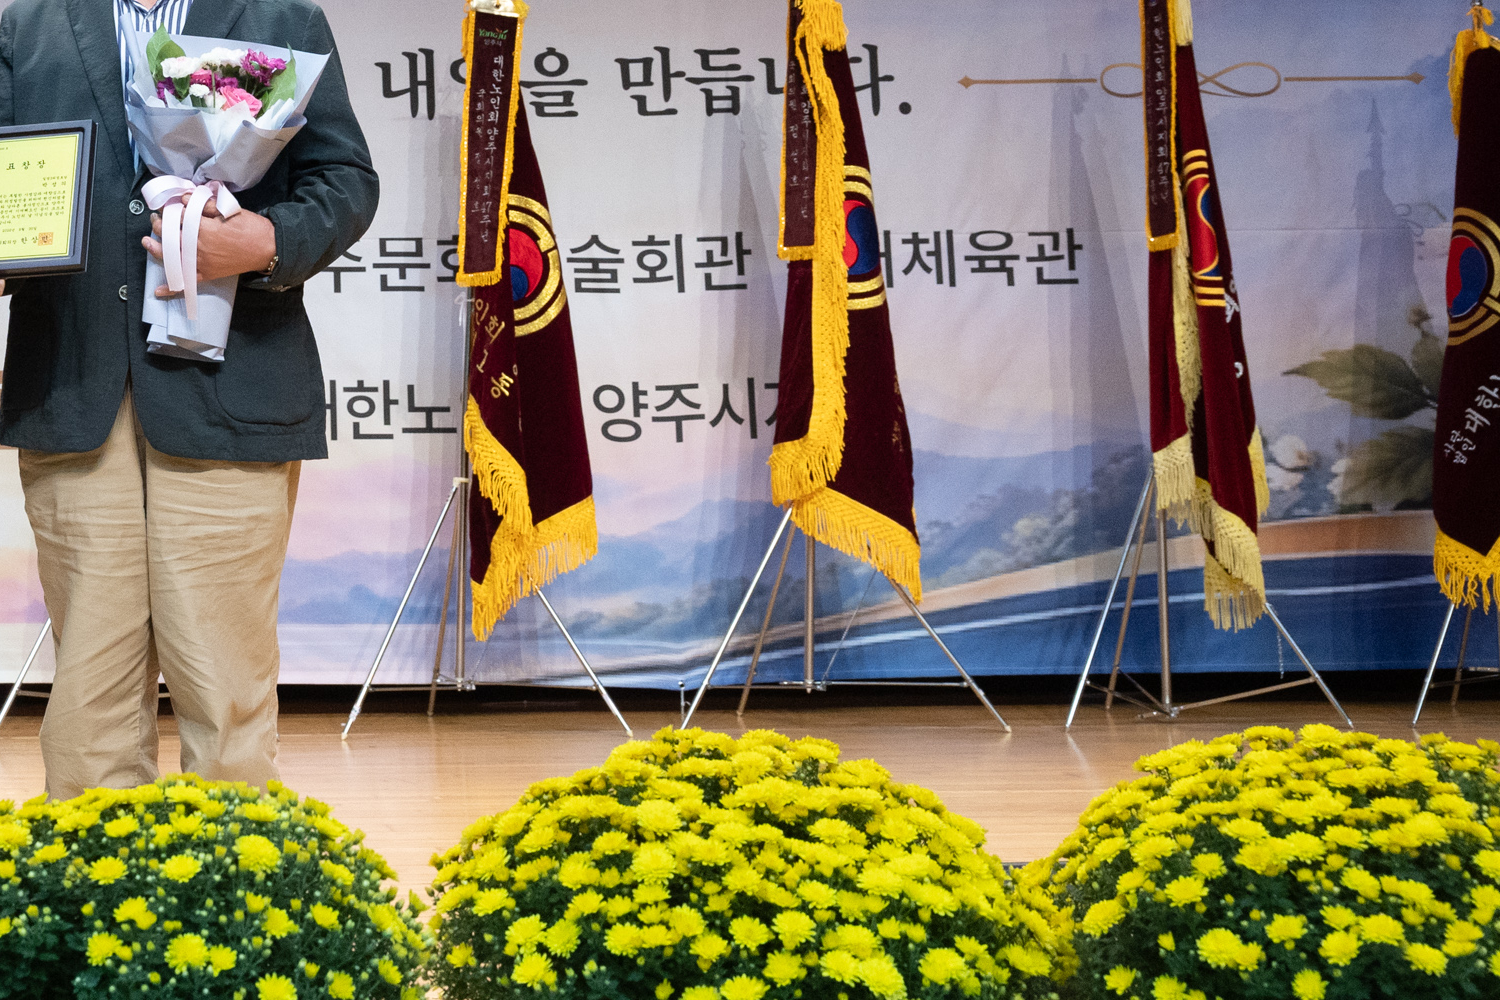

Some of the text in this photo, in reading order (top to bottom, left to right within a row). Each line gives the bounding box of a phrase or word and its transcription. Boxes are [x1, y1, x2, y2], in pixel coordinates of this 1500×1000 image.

[374, 46, 588, 121] 내을
[488, 55, 504, 124] 대한노인회
[322, 228, 1083, 294] 문술회관 체육관
[592, 377, 780, 443] 양주시
[1465, 374, 1500, 433] 대한
